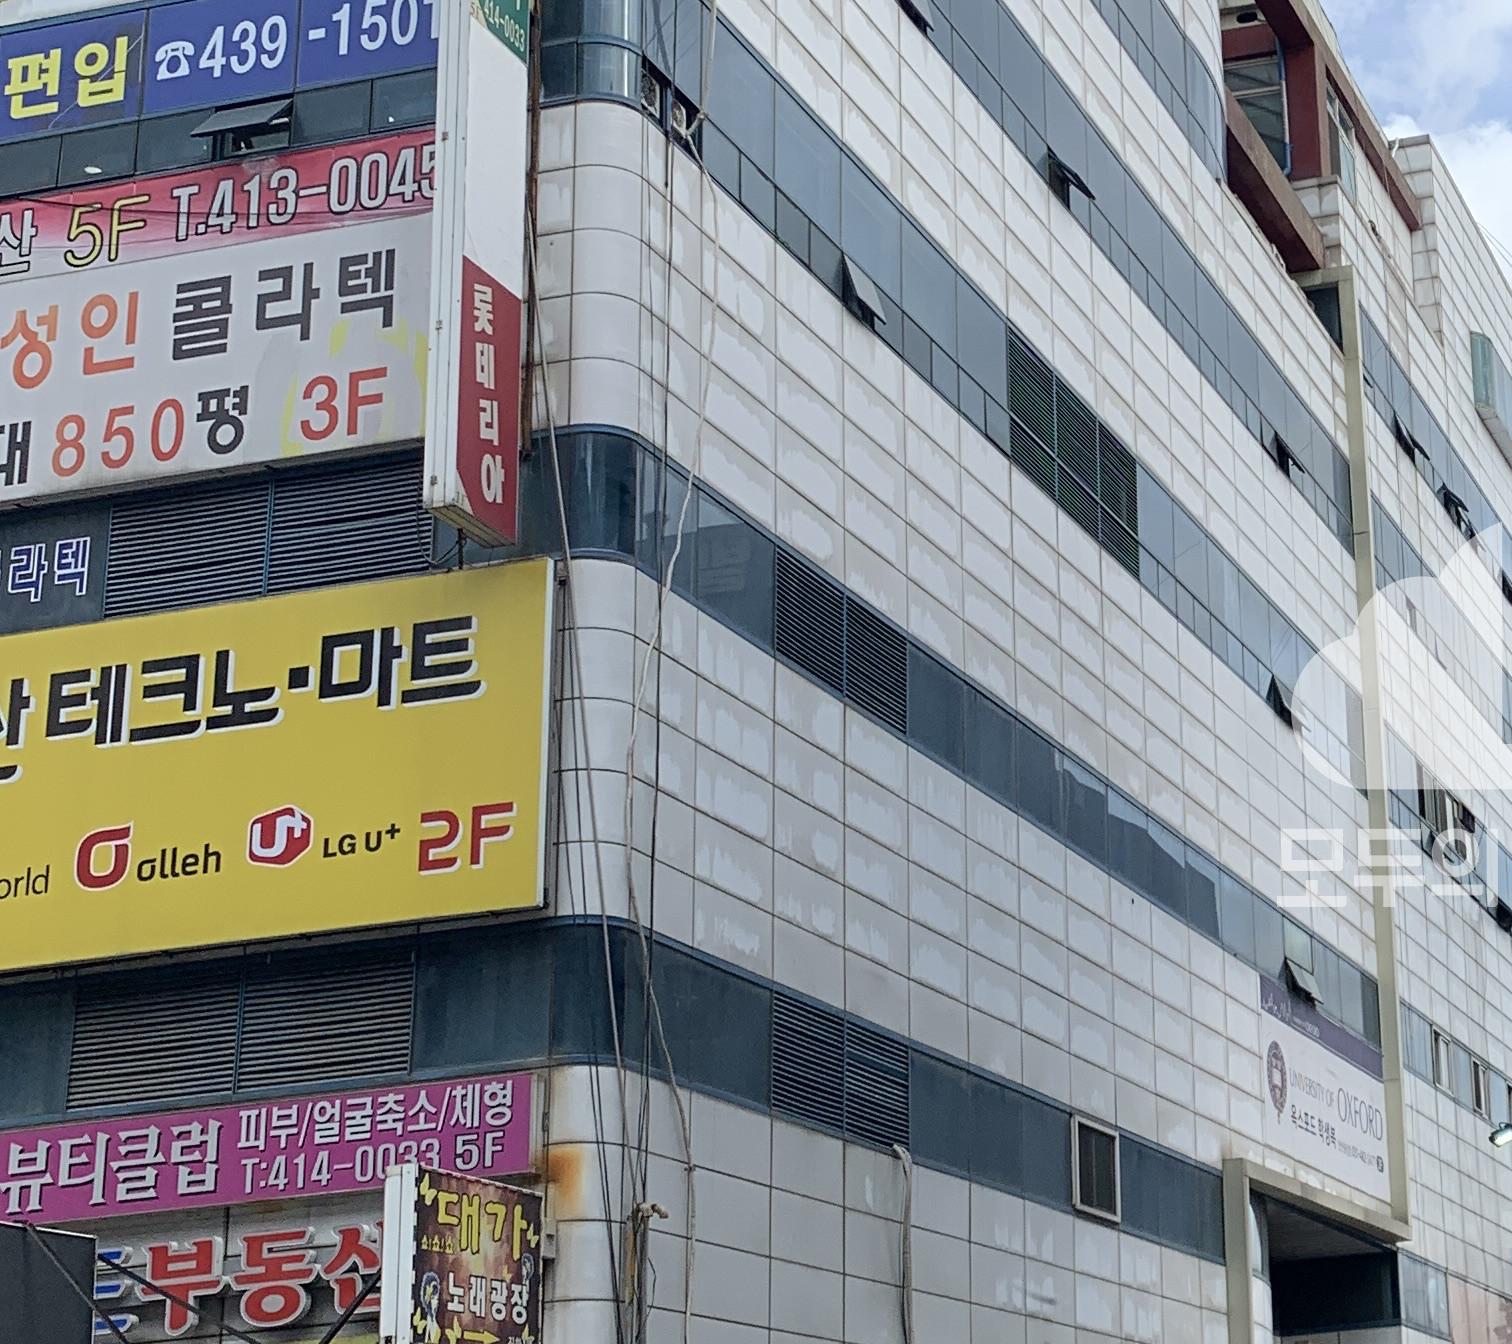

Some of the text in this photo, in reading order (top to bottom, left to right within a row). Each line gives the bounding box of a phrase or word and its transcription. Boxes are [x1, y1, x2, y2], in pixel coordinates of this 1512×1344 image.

[4, 35, 127, 120] 편입
[63, 194, 151, 266] 5F
[0, 248, 396, 391] 성인 콜라텍
[51, 384, 249, 478] 850평
[299, 366, 388, 441] 3F
[470, 281, 505, 507] 롯데리아
[417, 801, 517, 875] 2F
[1337, 1087, 1384, 1142] OXFORD
[2, 1116, 223, 1217] 뷰티클럽
[455, 1131, 505, 1174] 5F
[437, 1191, 529, 1262] 대가
[447, 1271, 530, 1325] 노래광장
